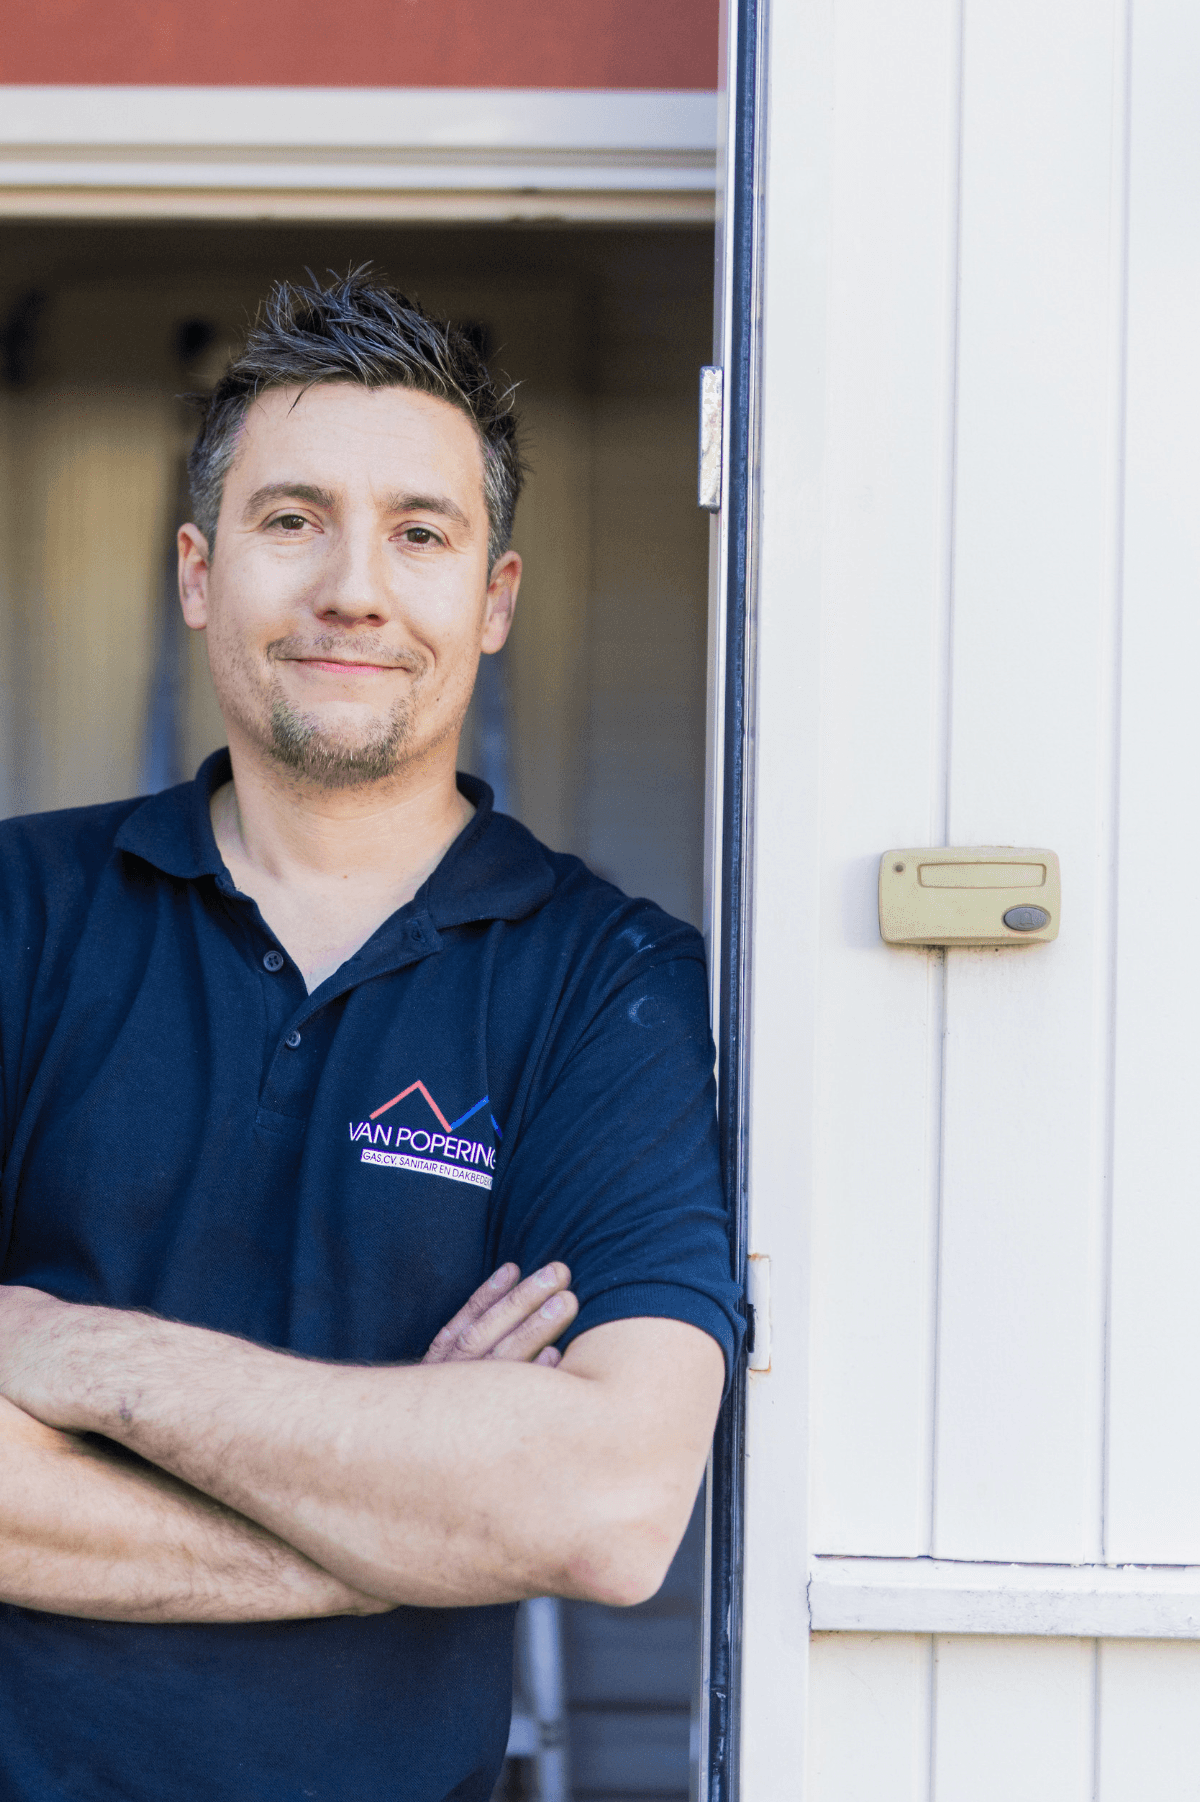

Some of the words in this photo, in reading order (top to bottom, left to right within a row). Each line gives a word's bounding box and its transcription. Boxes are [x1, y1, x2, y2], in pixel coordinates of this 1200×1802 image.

[349, 1122, 392, 1146] VAN
[399, 1157, 438, 1172] SANITAIR
[439, 1166, 451, 1175] EN
